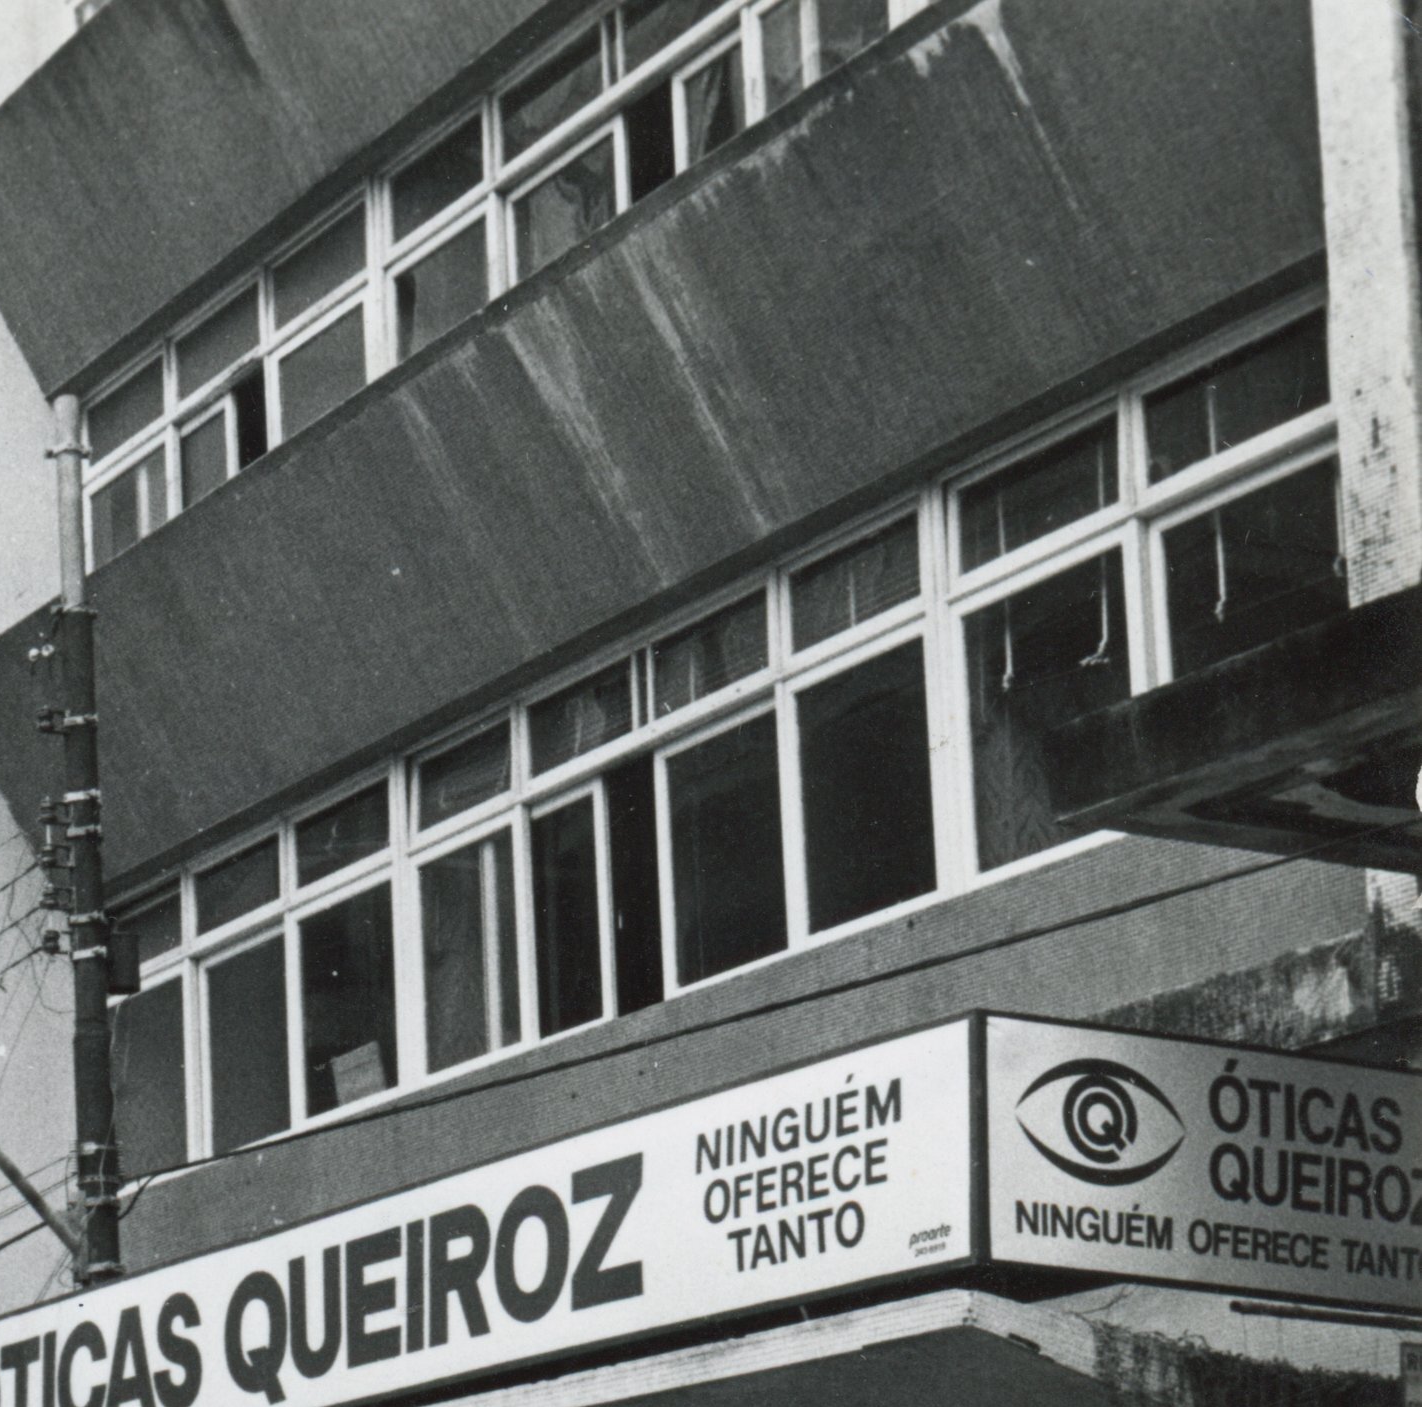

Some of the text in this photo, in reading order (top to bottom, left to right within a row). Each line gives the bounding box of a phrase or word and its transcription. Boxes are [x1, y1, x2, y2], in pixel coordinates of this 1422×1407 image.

[695, 1074, 903, 1175] NINGUÉM
[1208, 1058, 1403, 1155] ÓTICAS
[703, 1139, 890, 1224] OFERECE
[225, 1152, 644, 1401] QUEIROZ
[727, 1201, 866, 1273] TANTO
[1015, 1201, 1422, 1280] NINGUÉM OFERECE TANT
